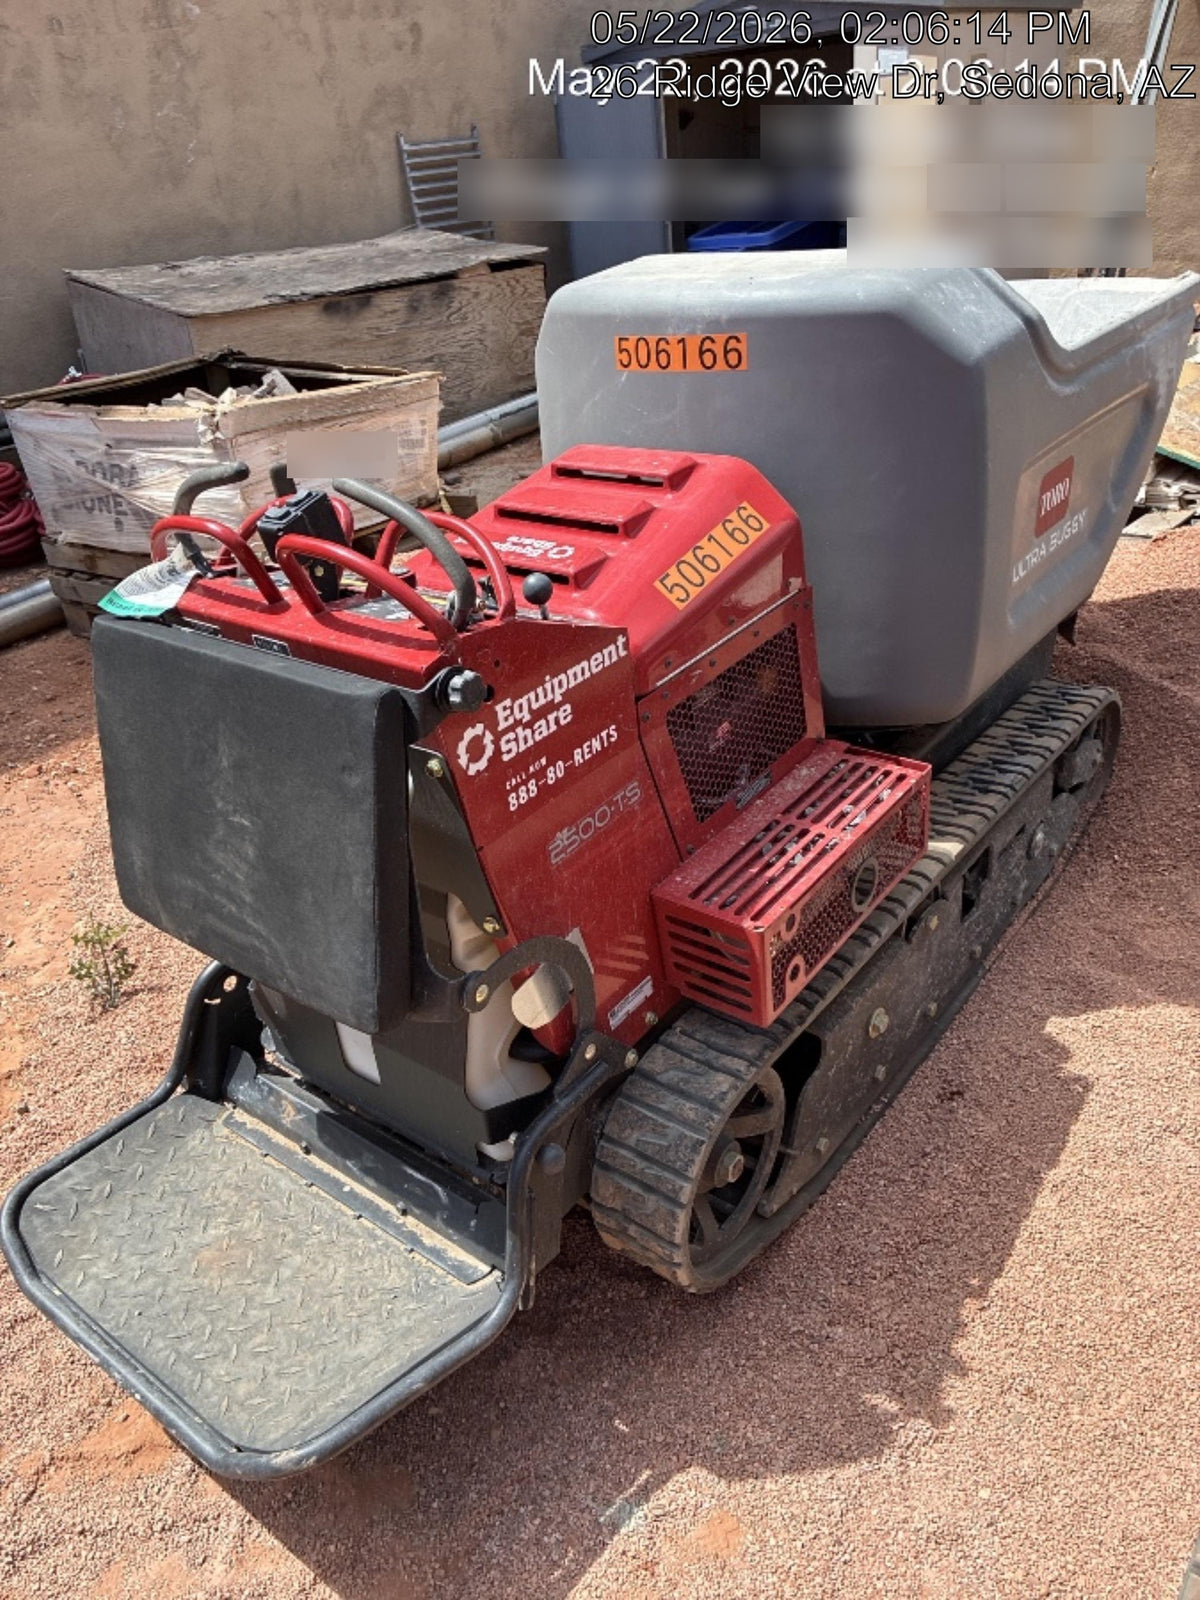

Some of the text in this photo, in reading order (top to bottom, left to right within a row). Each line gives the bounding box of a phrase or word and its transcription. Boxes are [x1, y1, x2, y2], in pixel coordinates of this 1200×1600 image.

[617, 335, 743, 370] 506166
[657, 505, 765, 604] 506166
[1012, 508, 1089, 583] ULTRA BUGGY
[495, 634, 628, 731] Equipment
[499, 702, 573, 763] Share
[508, 725, 618, 812] 888-80-RENTS
[506, 756, 547, 790] CALL NOW
